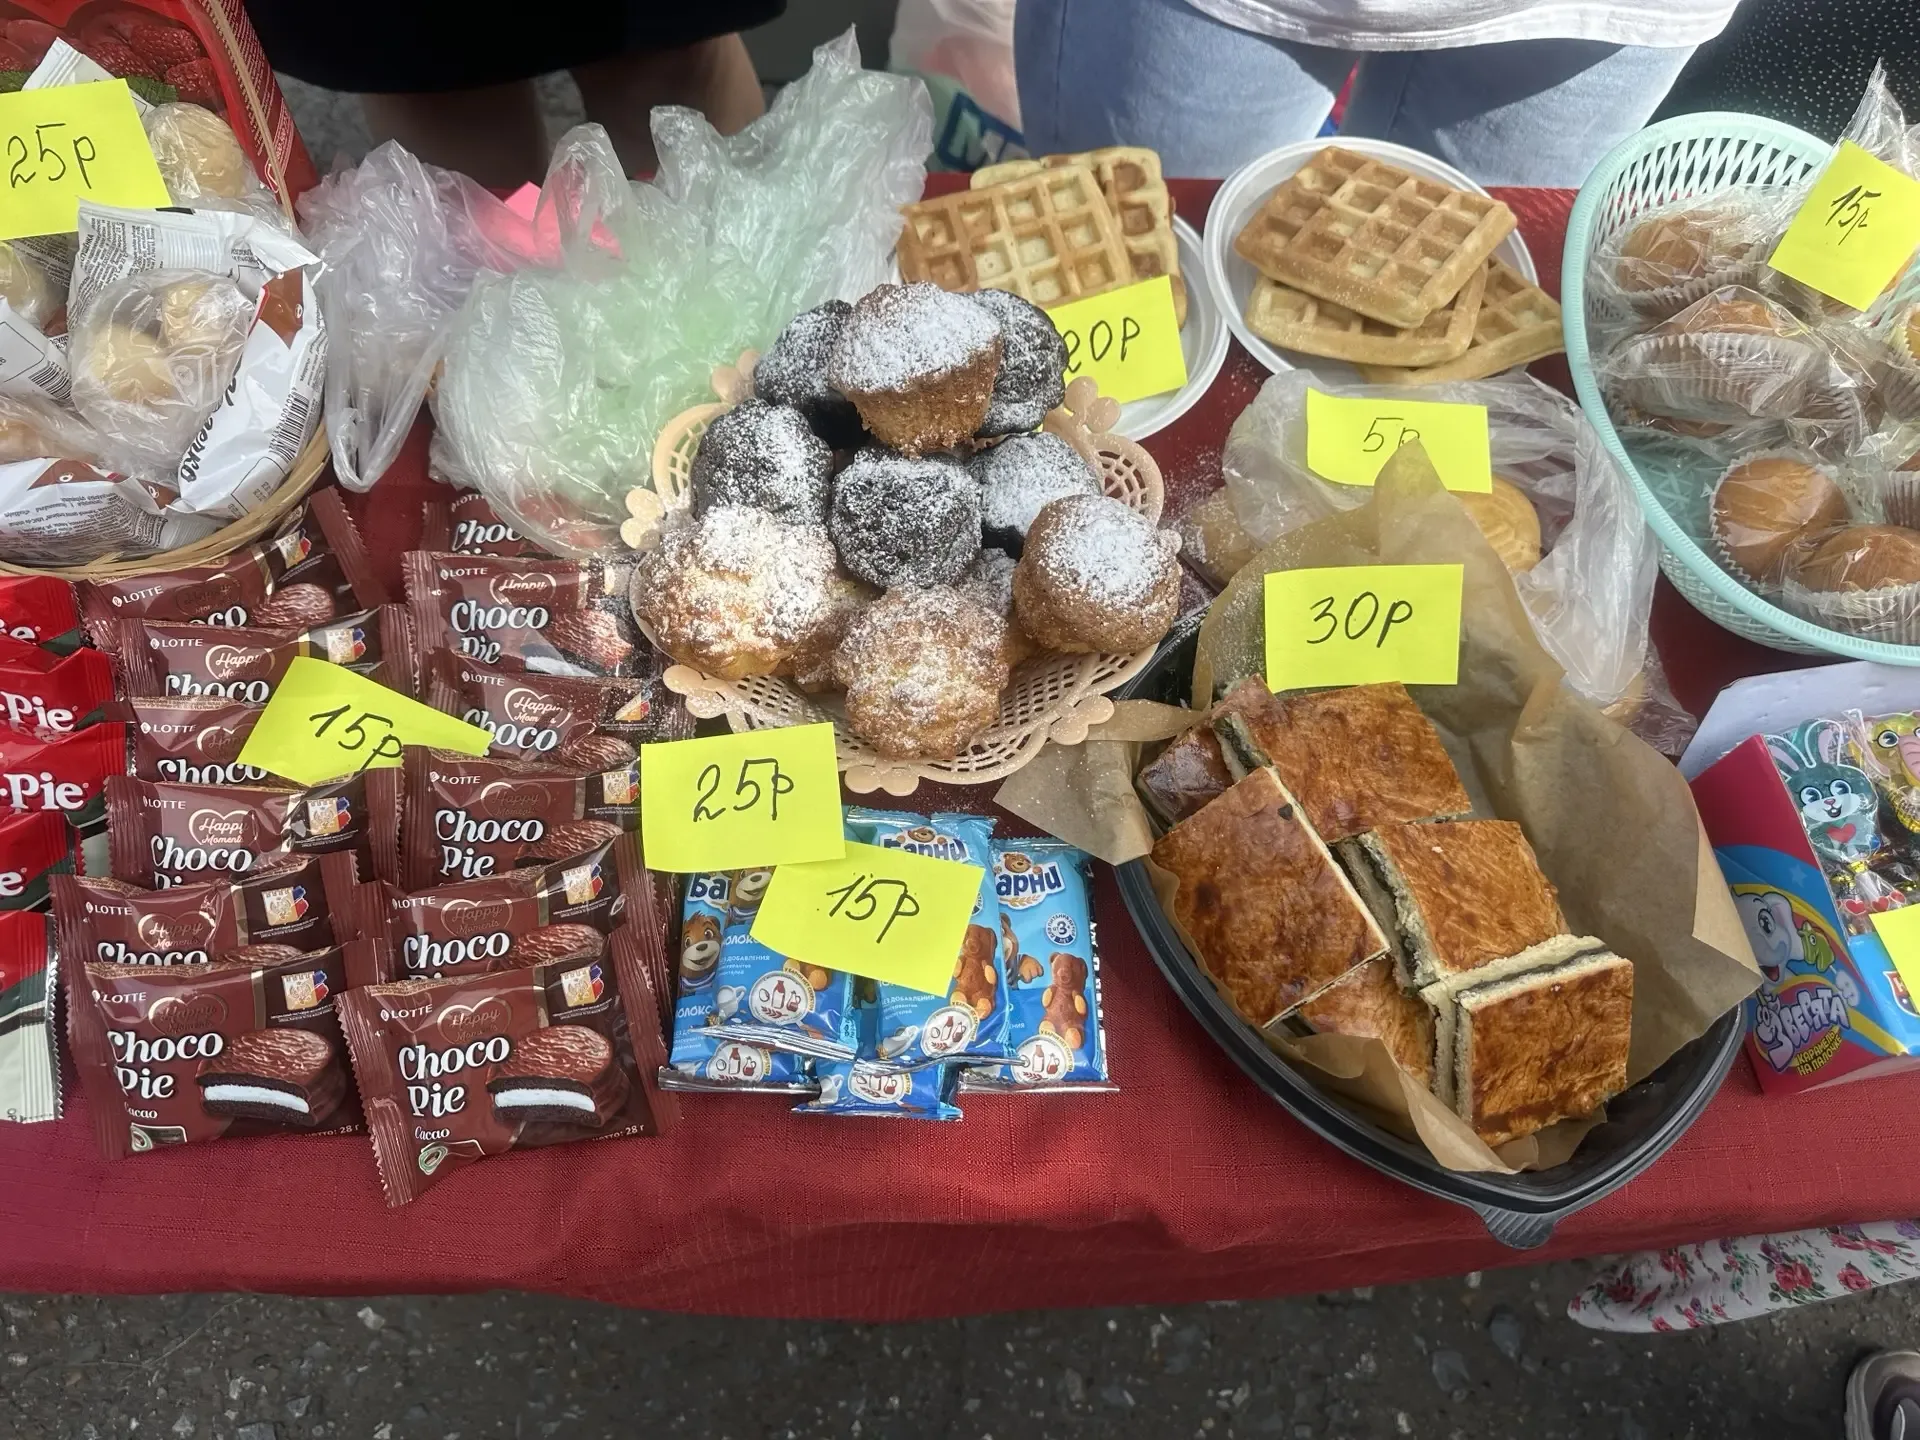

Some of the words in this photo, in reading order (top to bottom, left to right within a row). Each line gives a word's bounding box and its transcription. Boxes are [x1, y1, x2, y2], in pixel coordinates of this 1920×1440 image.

[7, 123, 96, 190] 25р
[1825, 184, 1882, 246] 15р
[452, 519, 525, 552] Choc
[450, 567, 488, 577] LOTTE
[123, 585, 164, 604] LOTTE
[451, 600, 550, 633] Choco
[1306, 591, 1414, 649] 30р
[162, 638, 203, 648] LOTTE
[470, 673, 506, 687] LOTTE
[154, 724, 197, 733] LOTTE
[307, 703, 404, 775] 15р
[441, 775, 481, 785] LOTTE
[692, 758, 795, 821] 25р
[149, 800, 187, 810] LOTTE
[198, 817, 247, 834] Happy
[435, 809, 545, 844] Choco
[150, 834, 253, 872] Choco
[438, 844, 496, 879] Pie
[94, 904, 133, 916] LOTTE
[397, 896, 436, 909] LOTTE
[826, 874, 921, 944] 15р
[148, 920, 204, 937] Happy
[403, 931, 511, 970] Choco
[103, 991, 147, 1004] LOTTE
[390, 1003, 433, 1019] LOTTE
[449, 1008, 501, 1029] Happy
[1756, 985, 1851, 1073] ЗВЕРЯТА
[107, 1031, 224, 1064] Choco
[399, 1037, 510, 1081] Choco
[1797, 1031, 1838, 1063] КАРАМЕЛЬ
[1797, 1060, 1813, 1076] НА
[1812, 1035, 1843, 1071] ПАЛОЧКЕ
[115, 1064, 175, 1099] Pie
[406, 1083, 466, 1118] Pie
[339, 1125, 353, 1135] 28
[415, 1126, 450, 1141] Cacao
[625, 1126, 639, 1136] 28
